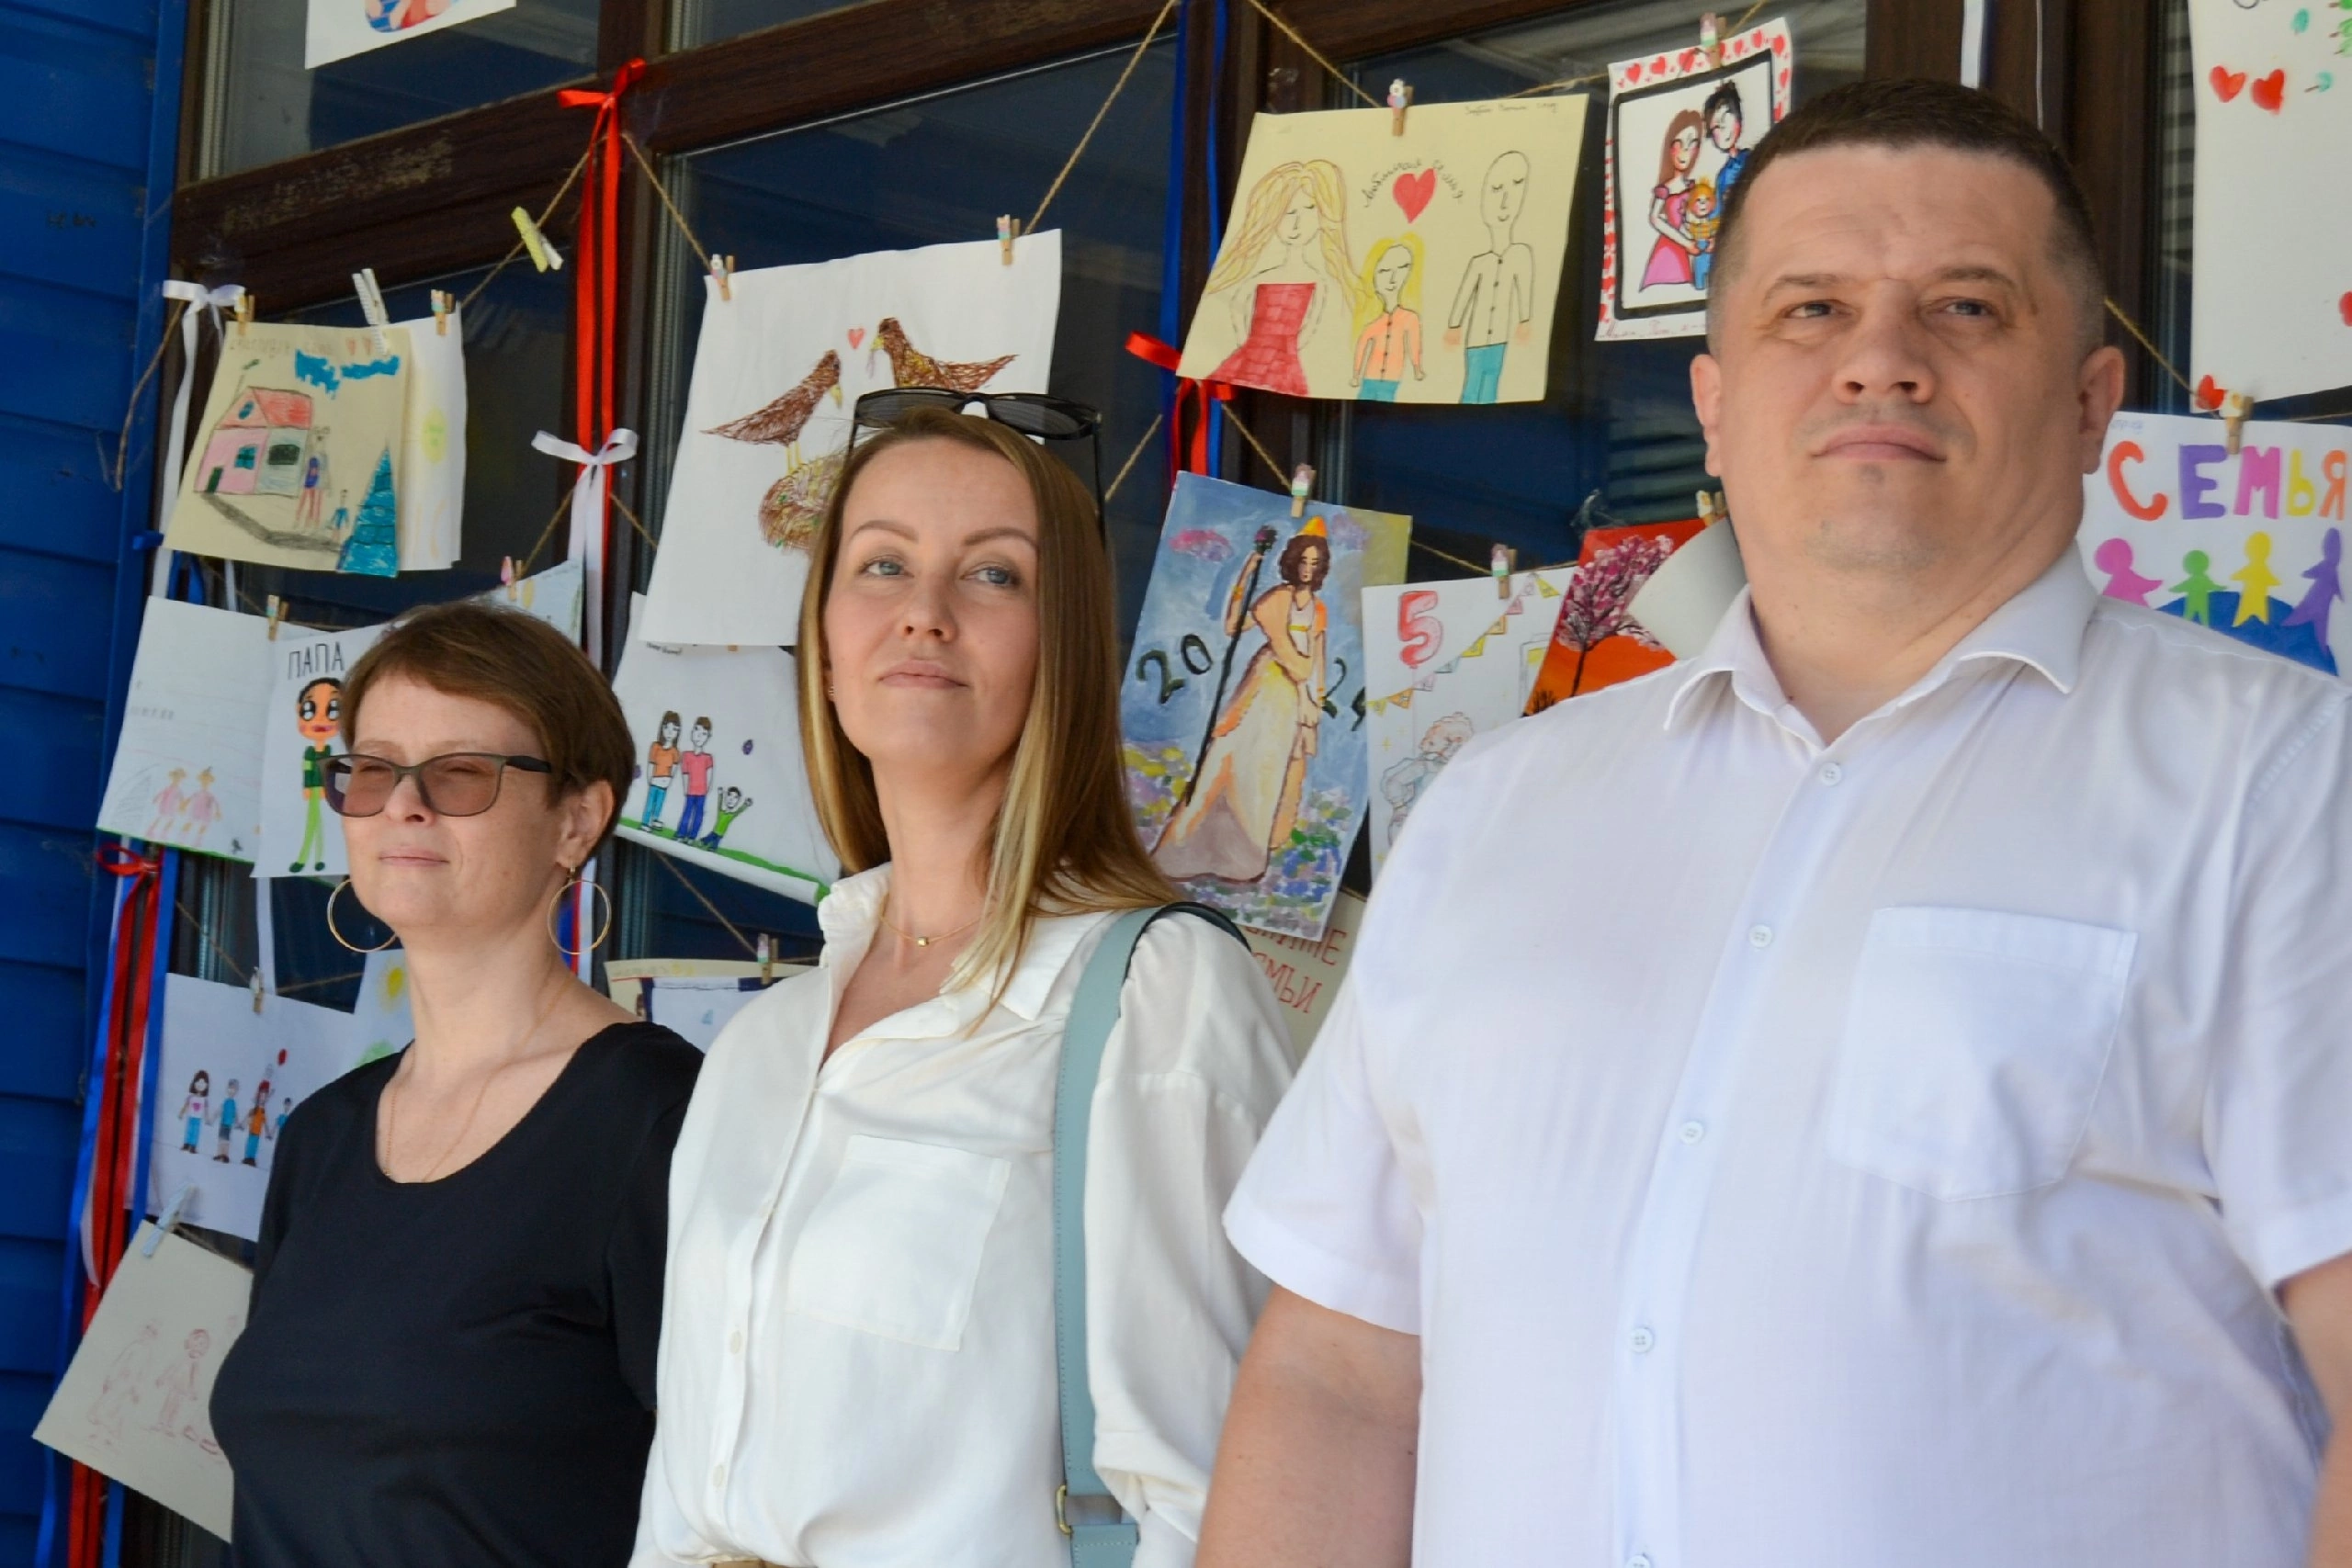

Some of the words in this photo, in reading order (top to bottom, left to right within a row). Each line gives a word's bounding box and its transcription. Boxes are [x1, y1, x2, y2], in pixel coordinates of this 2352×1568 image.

[2108, 440, 2346, 521] СЕМЬЯ
[288, 641, 345, 680] ПАПА
[1397, 590, 1443, 667] 5
[1136, 634, 1214, 704] 20
[1252, 952, 1323, 1013] МЬИ
